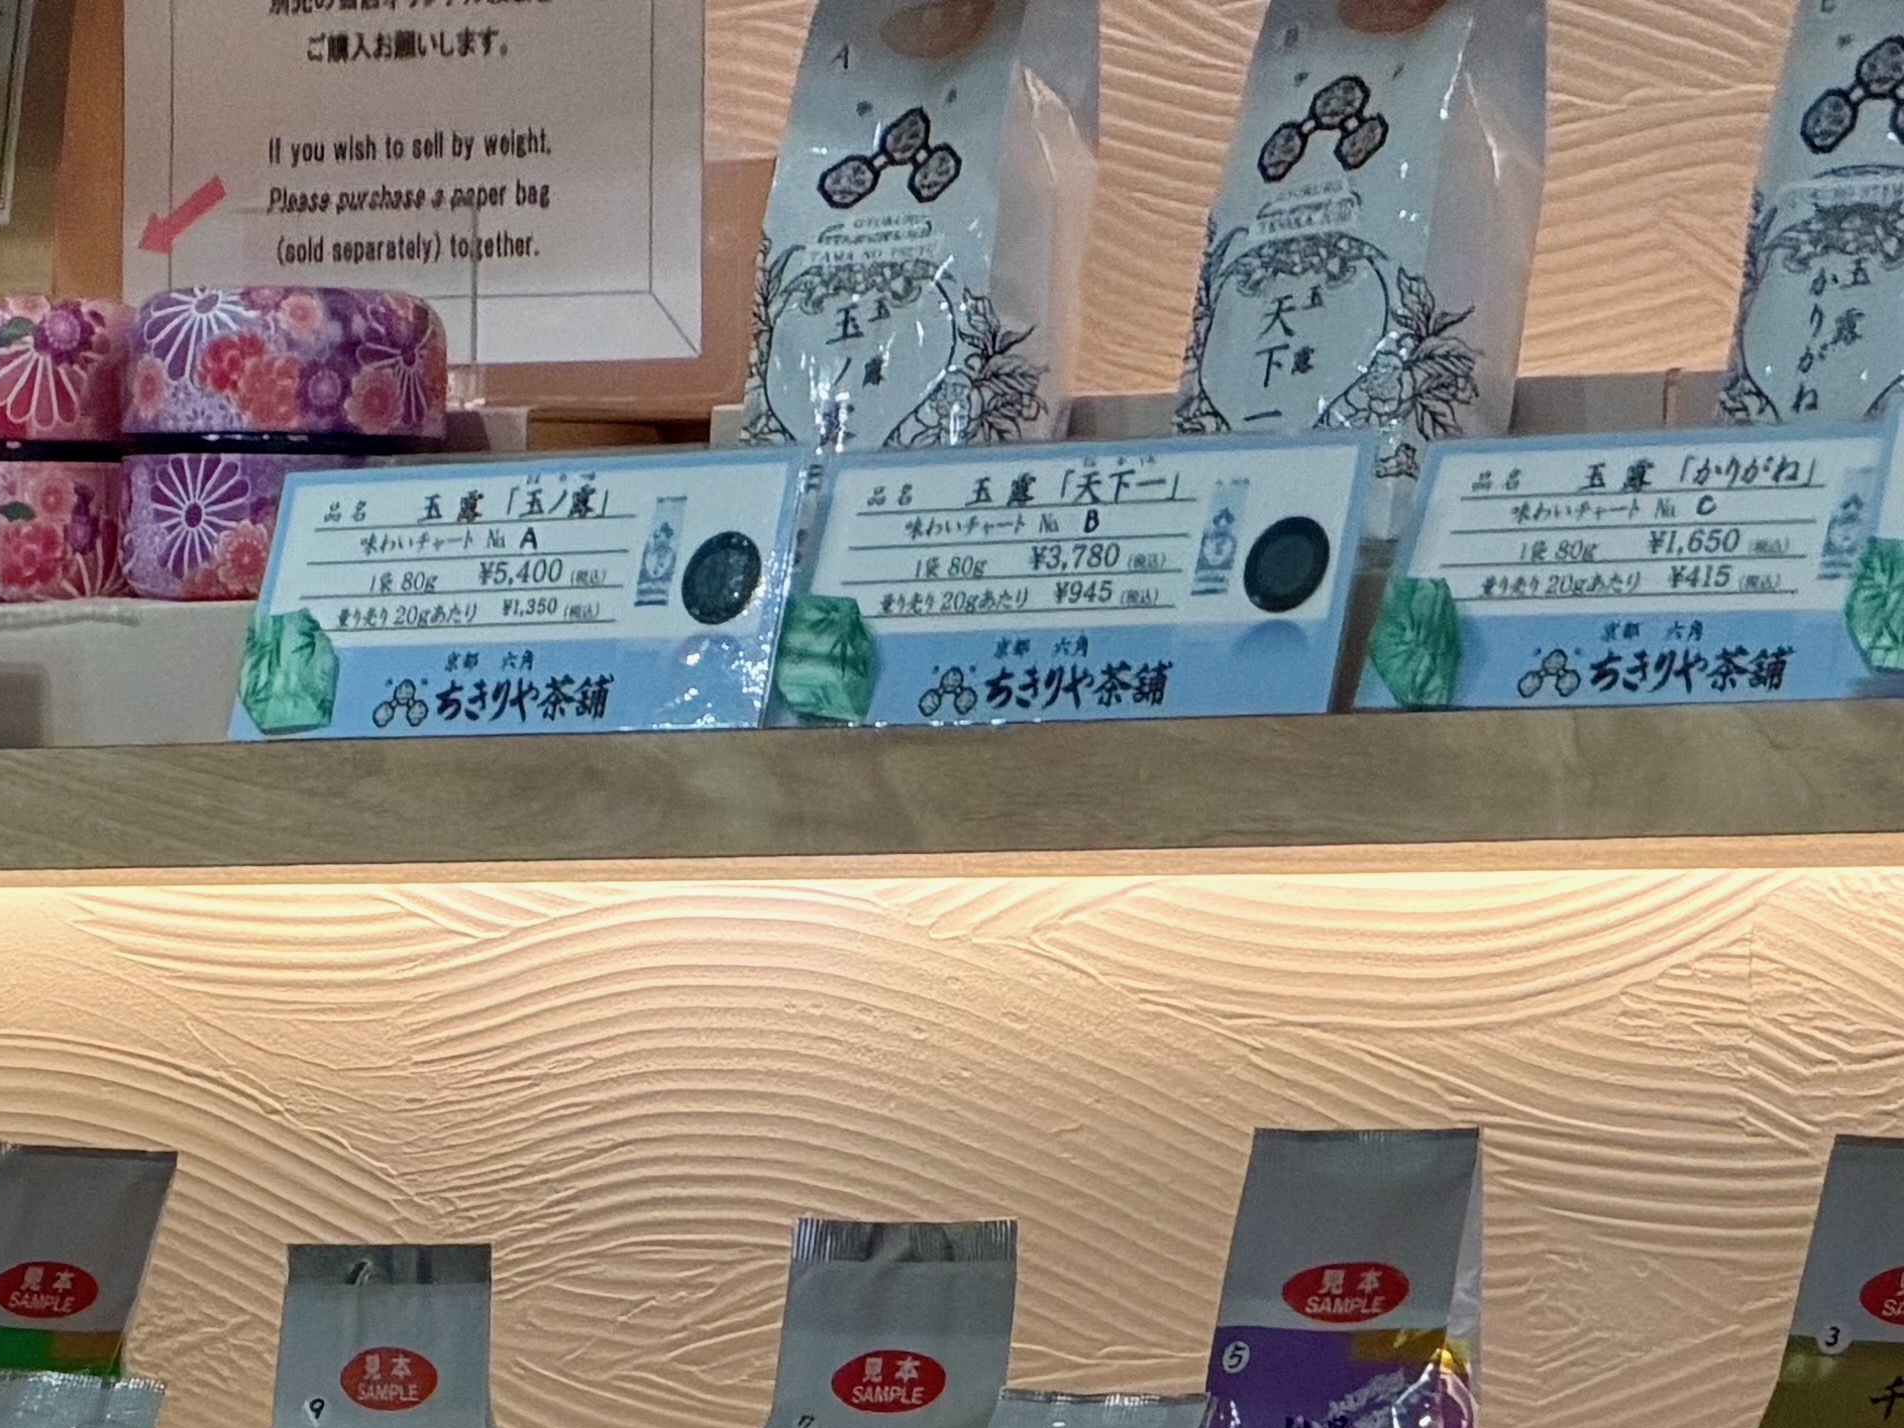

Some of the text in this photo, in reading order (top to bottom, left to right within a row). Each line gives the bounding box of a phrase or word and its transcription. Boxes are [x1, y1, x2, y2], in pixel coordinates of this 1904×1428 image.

[306, 26, 508, 62] ご購入お願いします。
[268, 137, 281, 164] If
[291, 141, 324, 167] you
[334, 134, 376, 161] wish
[386, 135, 404, 159] to
[412, 129, 442, 159] sell
[452, 131, 474, 160] by
[267, 178, 550, 214] Please purchase a paper bag
[277, 236, 324, 266] (sold
[332, 231, 440, 264] separately)
[1696, 495, 1716, 516] C
[1084, 510, 1099, 532] B
[520, 527, 538, 550] A
[1649, 529, 1740, 554] ¥1,650
[948, 542, 1120, 577] 80g ¥3,780
[402, 558, 563, 592] 80g ¥5,400
[1670, 565, 1732, 587] ¥415
[1055, 580, 1113, 605] ¥945
[502, 597, 557, 617] ¥1,350
[1591, 644, 1796, 694] ちきりや茶舗
[437, 673, 614, 723] ちきりや茶舗
[986, 660, 1173, 710] ちきりや茶舗
[18, 1266, 76, 1294] 見本
[1319, 1268, 1382, 1295] 見本
[8, 1290, 77, 1313] SAMPLE
[1304, 1294, 1387, 1317] SAMPLE
[861, 1356, 920, 1384] 見本
[356, 1382, 419, 1401] SAMPLE
[851, 1384, 925, 1405] SAMPLE
